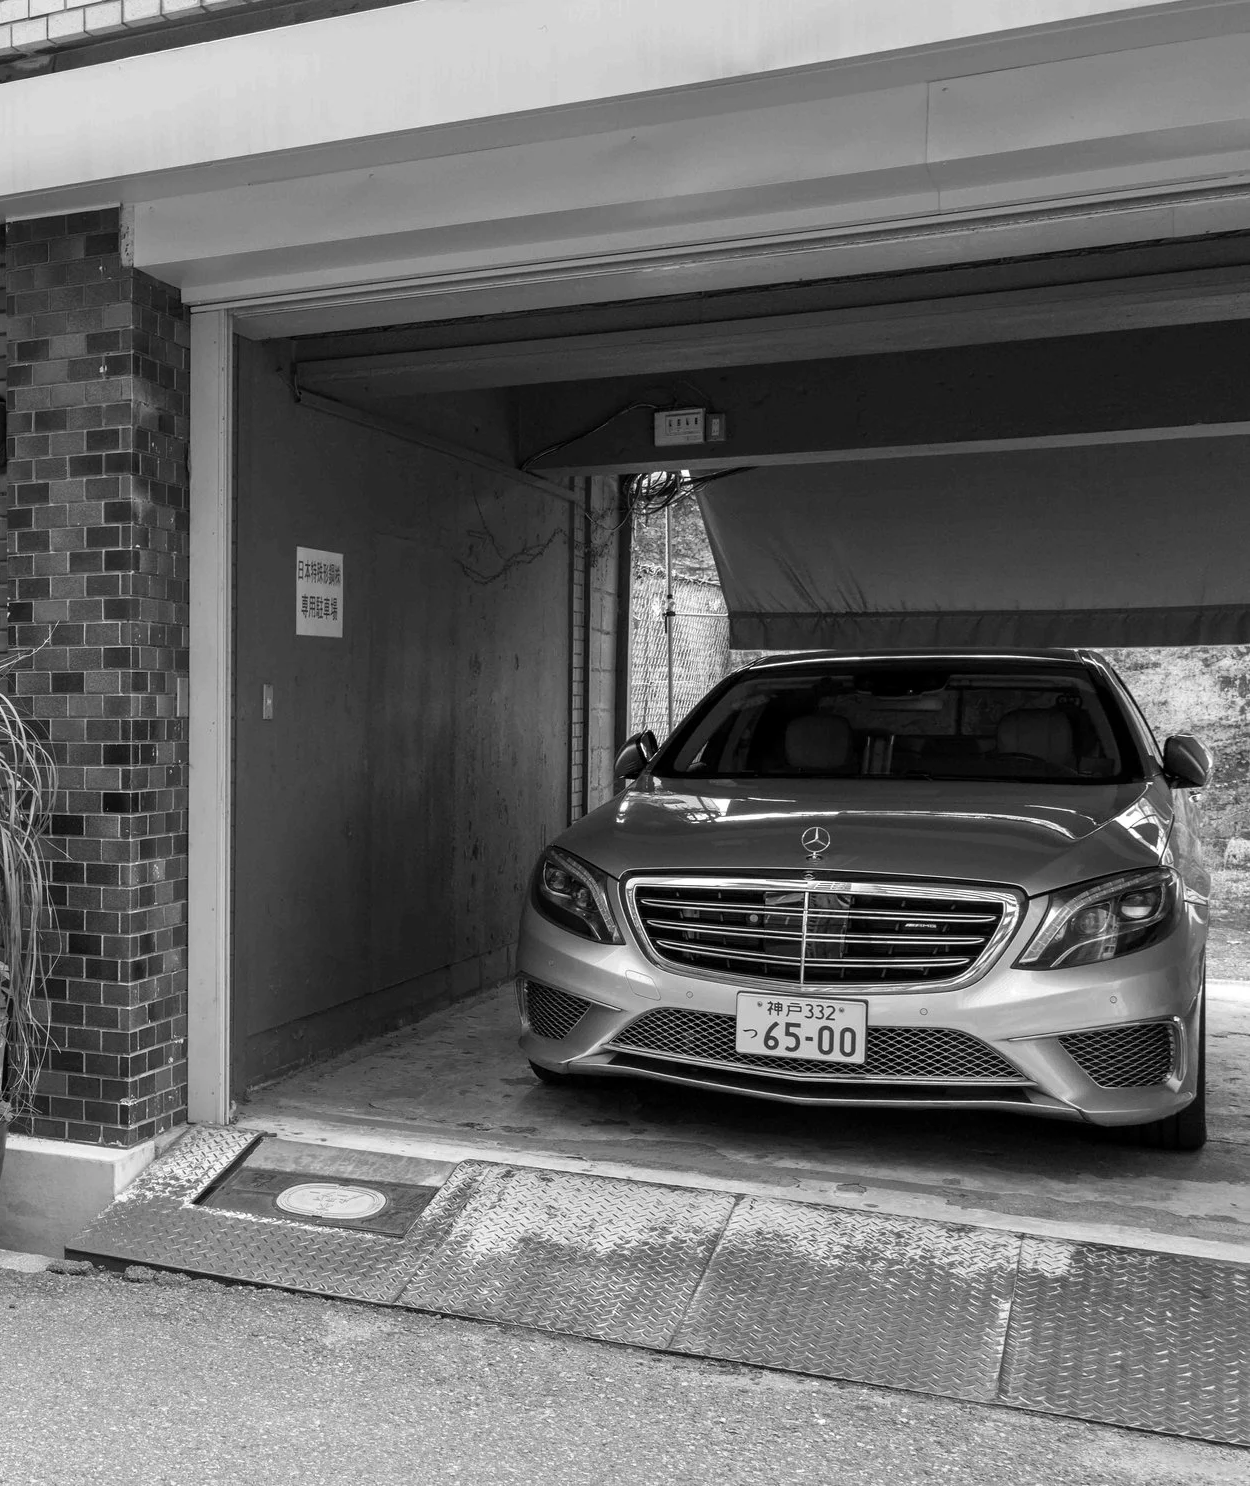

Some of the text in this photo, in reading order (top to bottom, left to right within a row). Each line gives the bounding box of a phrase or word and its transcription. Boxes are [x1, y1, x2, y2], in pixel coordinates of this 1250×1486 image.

[301, 594, 338, 620] 専用駐車場
[743, 1021, 856, 1058] つ 65-00
